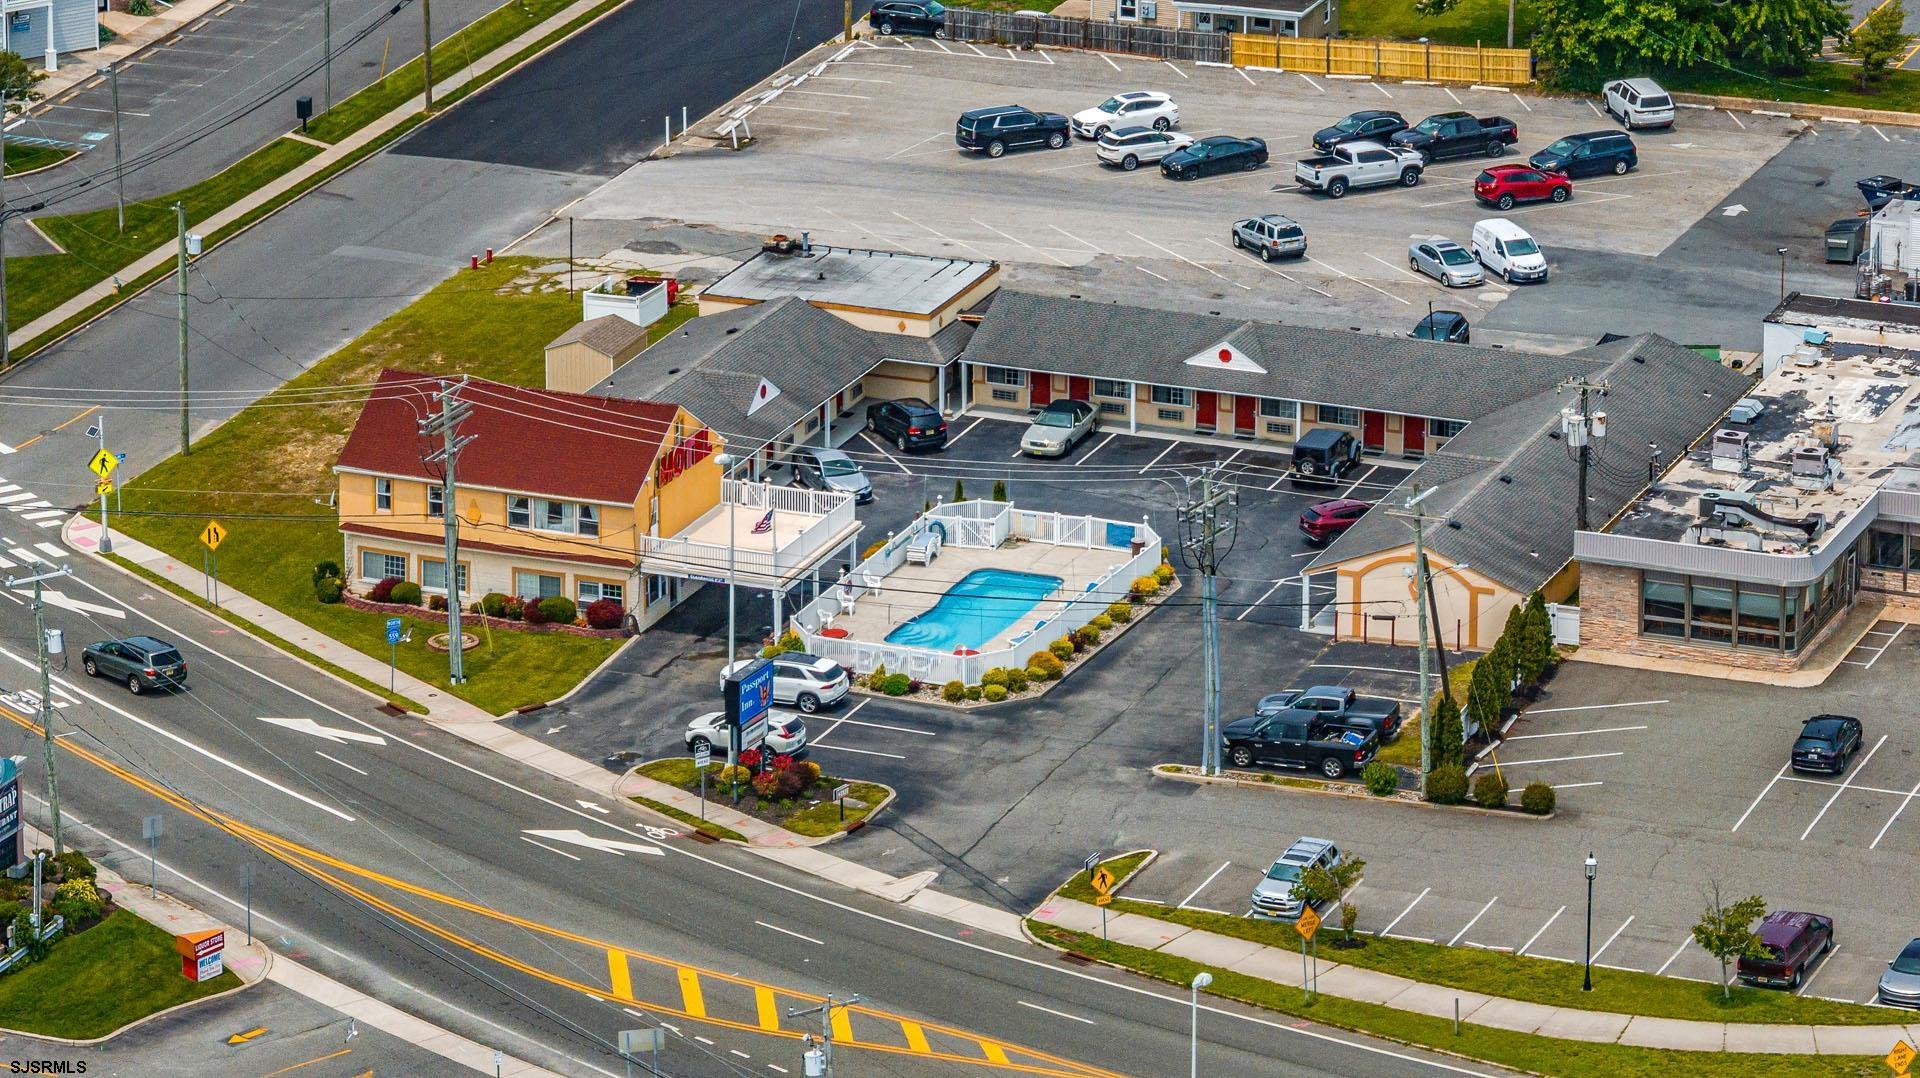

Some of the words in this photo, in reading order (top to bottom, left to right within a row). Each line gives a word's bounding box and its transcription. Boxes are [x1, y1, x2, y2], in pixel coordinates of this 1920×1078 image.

[741, 671, 769, 695] Passport
[741, 699, 753, 712] Inn
[0, 810, 17, 827] RANT
[195, 940, 210, 951] LIQUOR
[210, 934, 223, 945] STORE
[199, 953, 221, 968] WELCOME
